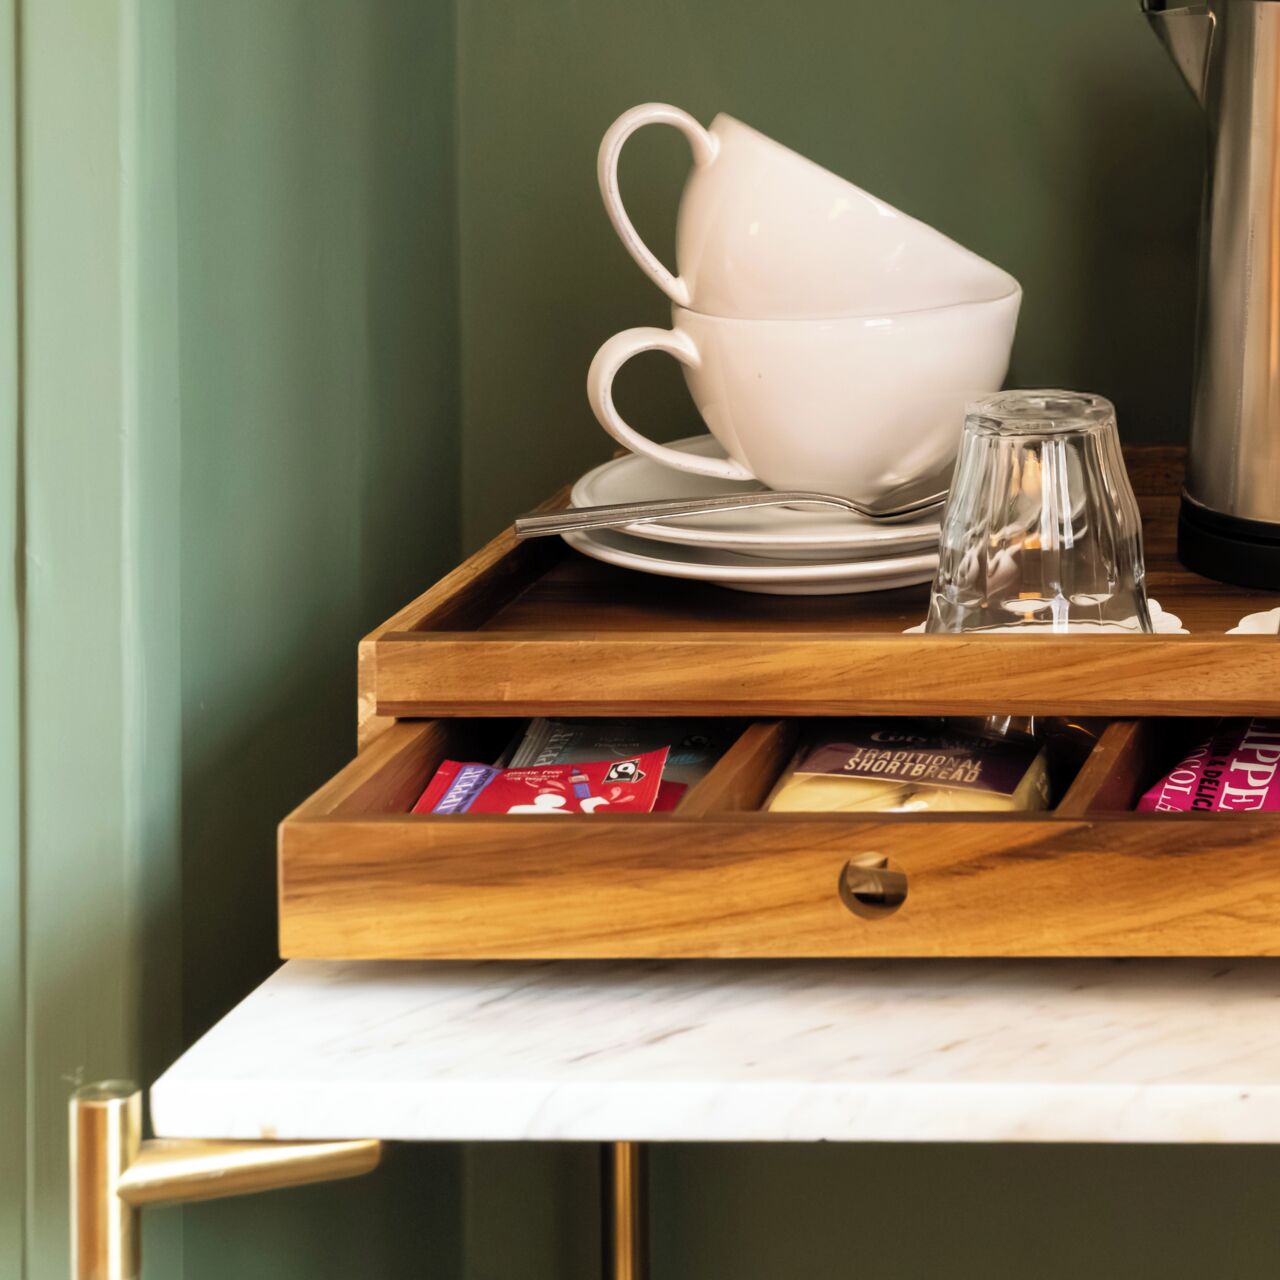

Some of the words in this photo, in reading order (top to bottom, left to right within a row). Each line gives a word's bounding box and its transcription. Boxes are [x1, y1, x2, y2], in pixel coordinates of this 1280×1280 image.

[843, 758, 981, 783] SHORTBREAD
[853, 747, 983, 772] TRADITIONAL
[1191, 770, 1224, 811] DELIC
